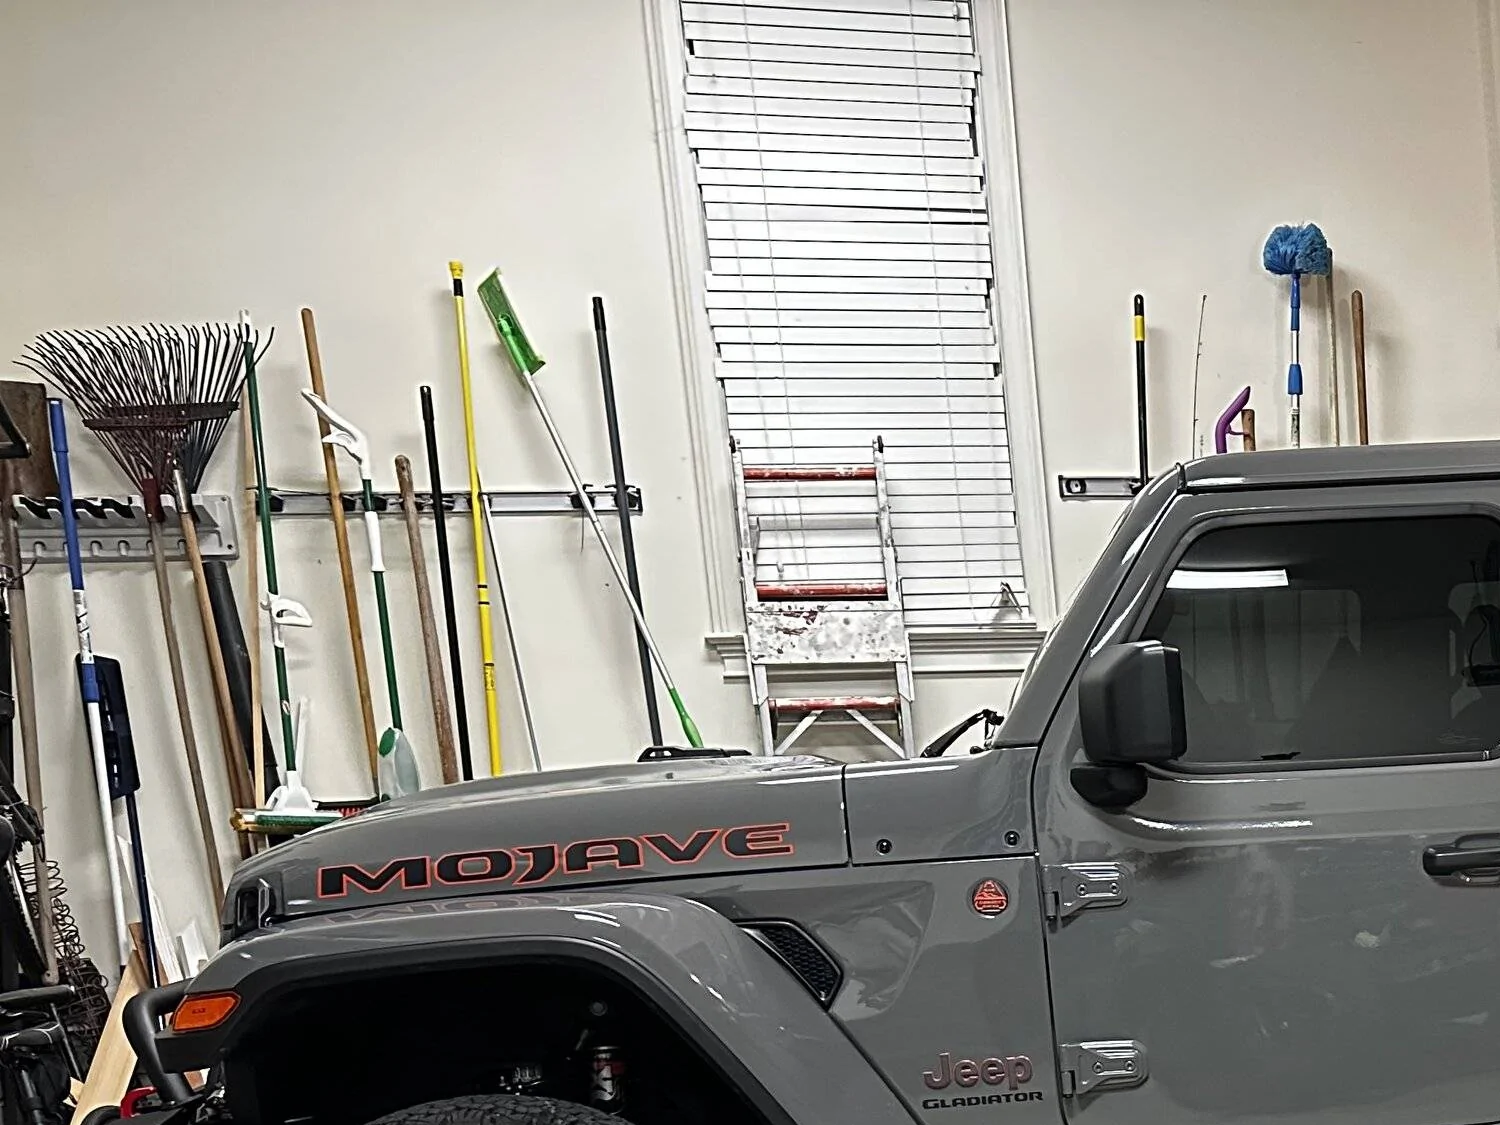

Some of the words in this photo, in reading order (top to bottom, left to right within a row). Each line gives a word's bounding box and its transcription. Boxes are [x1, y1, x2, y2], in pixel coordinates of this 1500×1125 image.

[316, 822, 794, 898] MOJAVE
[923, 1052, 1033, 1090] Jeep
[922, 1091, 1044, 1109] GLADIATOR
